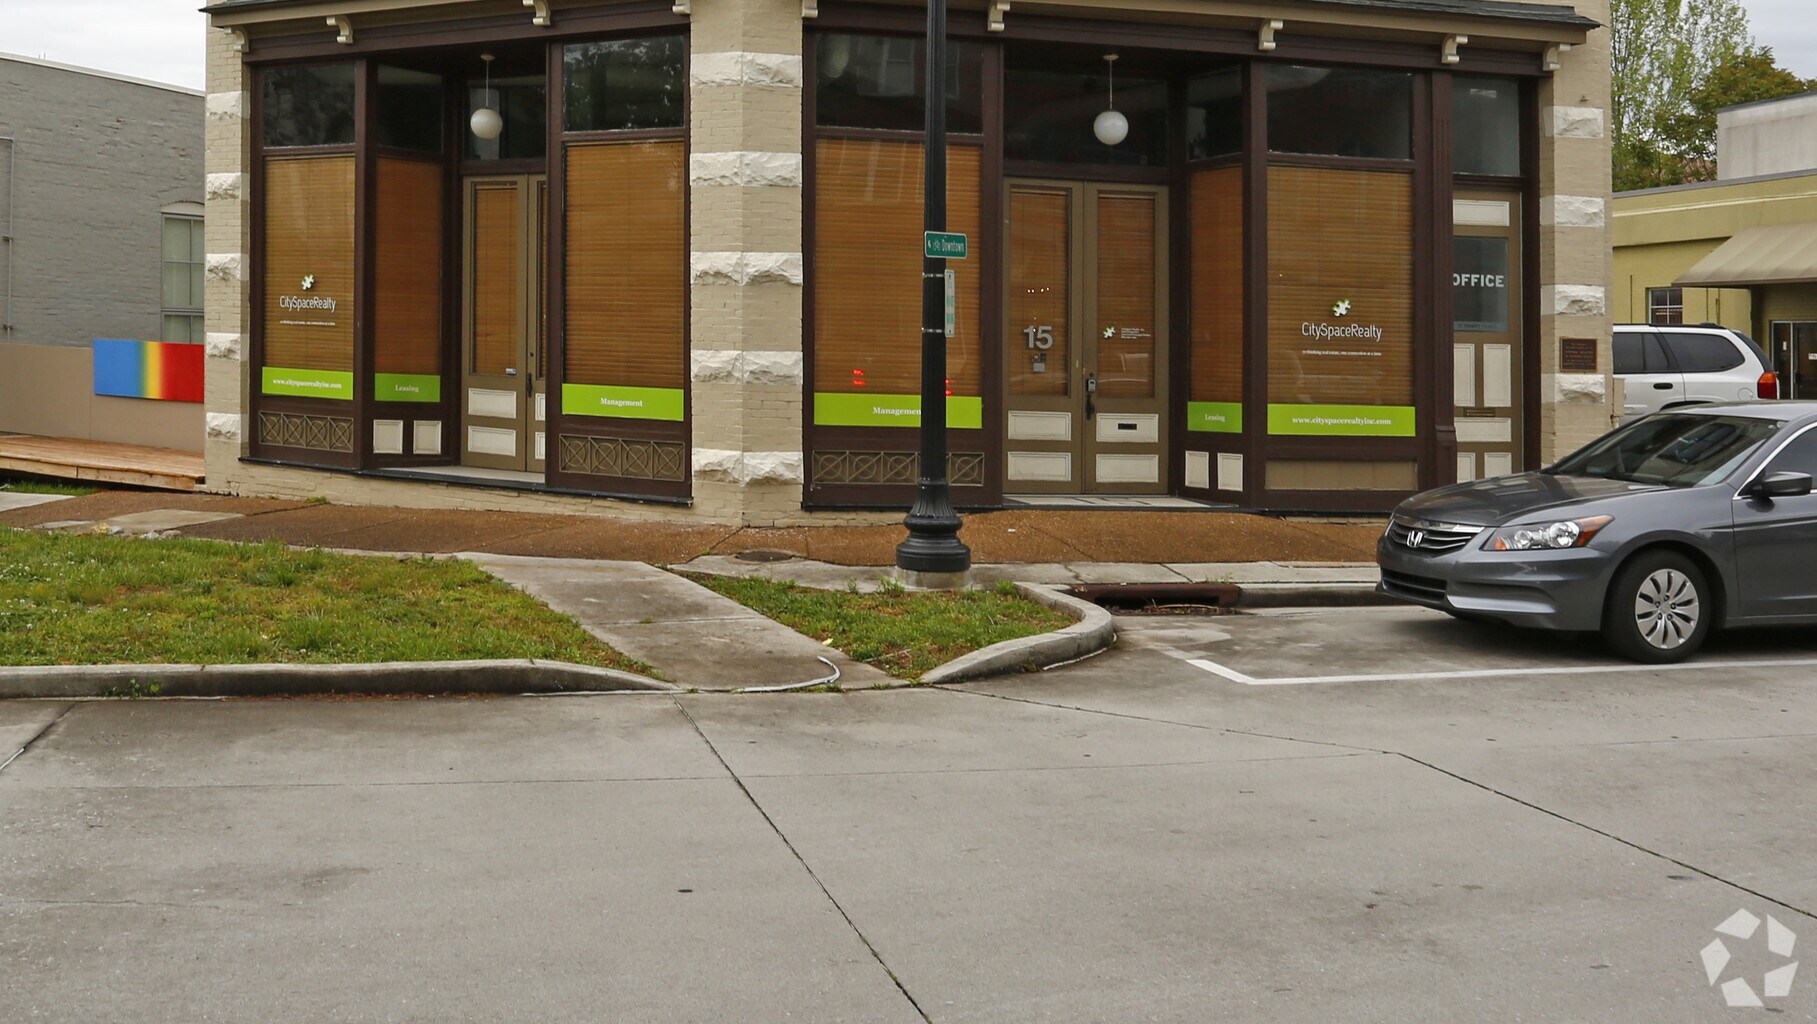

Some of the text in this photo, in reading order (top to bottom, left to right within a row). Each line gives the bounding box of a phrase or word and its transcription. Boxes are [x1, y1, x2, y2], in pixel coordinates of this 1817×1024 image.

[941, 239, 965, 252] Downtown
[1453, 272, 1505, 288] OFFICE
[280, 295, 336, 313] CitySpaceRealty
[1023, 325, 1054, 350] 15
[1301, 321, 1383, 343] CitySpaceRealty
[395, 384, 420, 393] Leasing
[600, 397, 643, 407] Management
[872, 406, 921, 416] Managemen
[1292, 416, 1392, 426] www.cityspacerealtyinc.com
